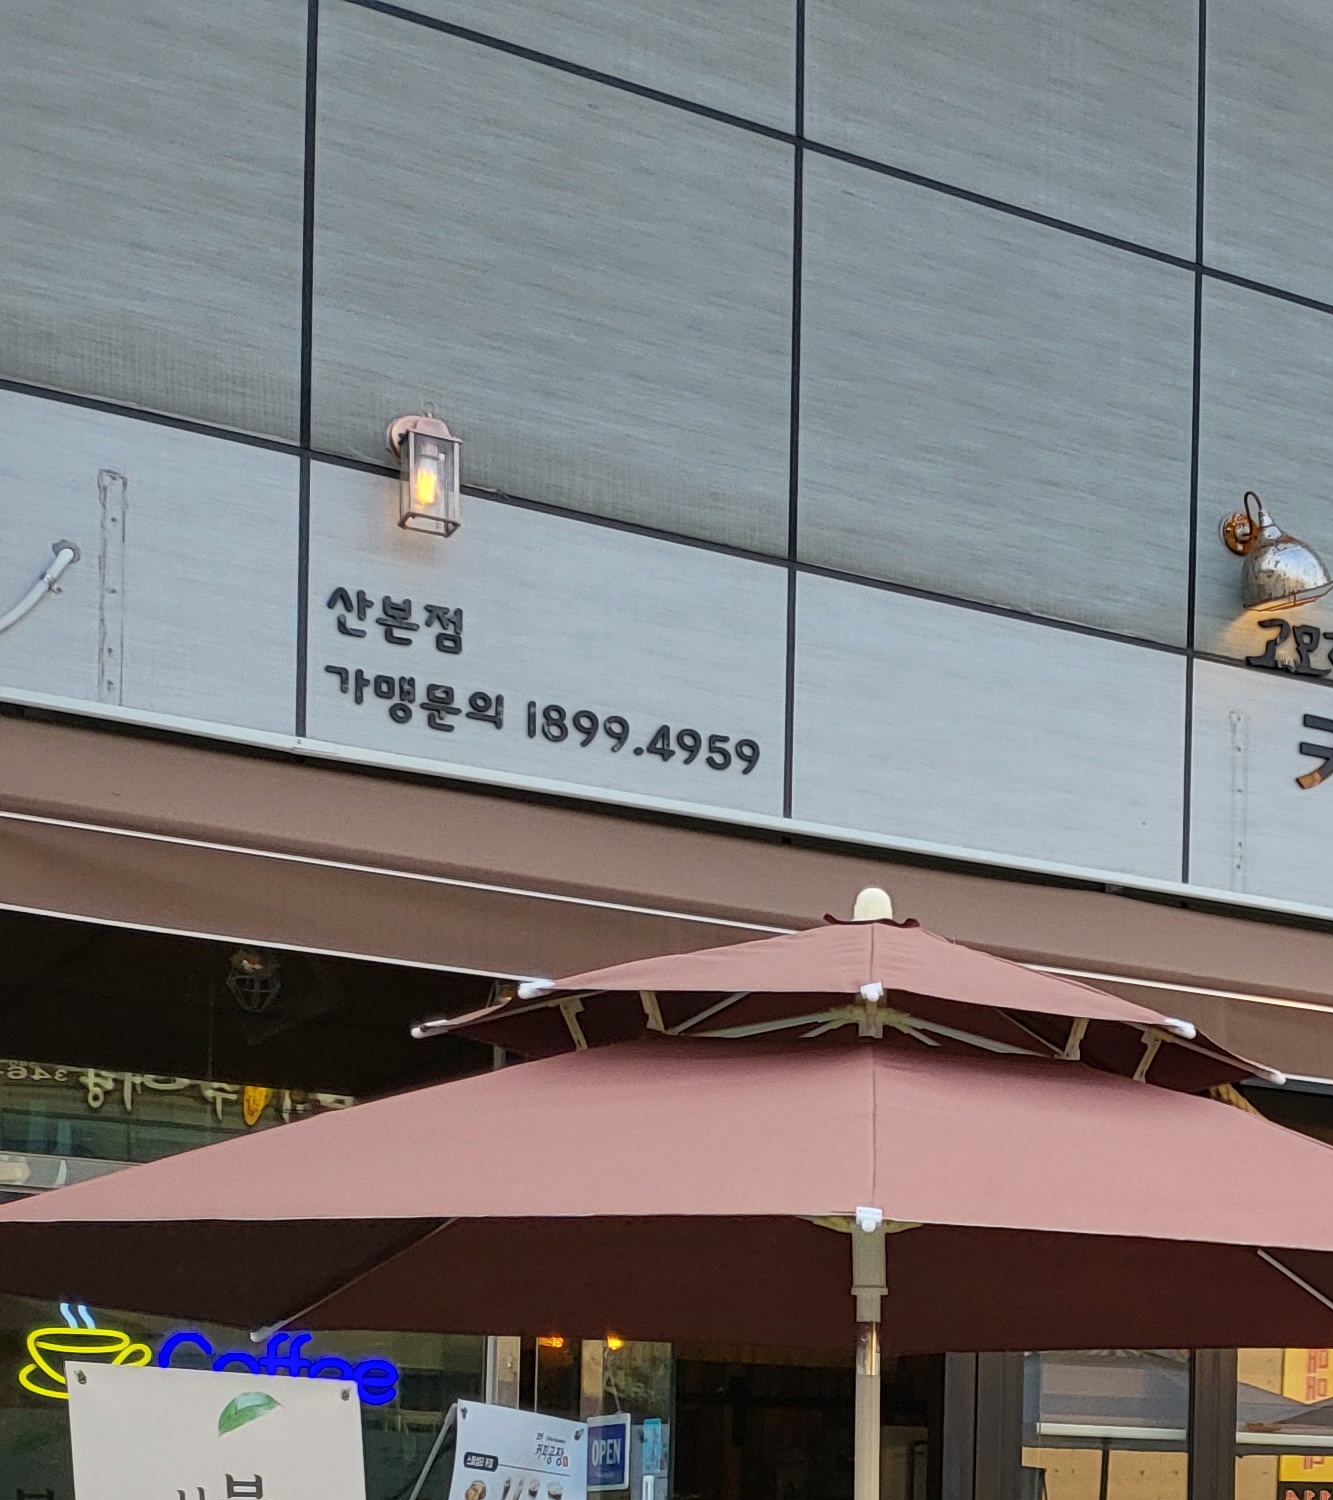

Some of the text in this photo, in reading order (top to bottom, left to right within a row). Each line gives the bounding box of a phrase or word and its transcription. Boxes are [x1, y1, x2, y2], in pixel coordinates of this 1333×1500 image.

[327, 585, 465, 655] 산본점
[325, 665, 761, 776] 가맹문의 1899.4959
[591, 1438, 621, 1467] OPEN
